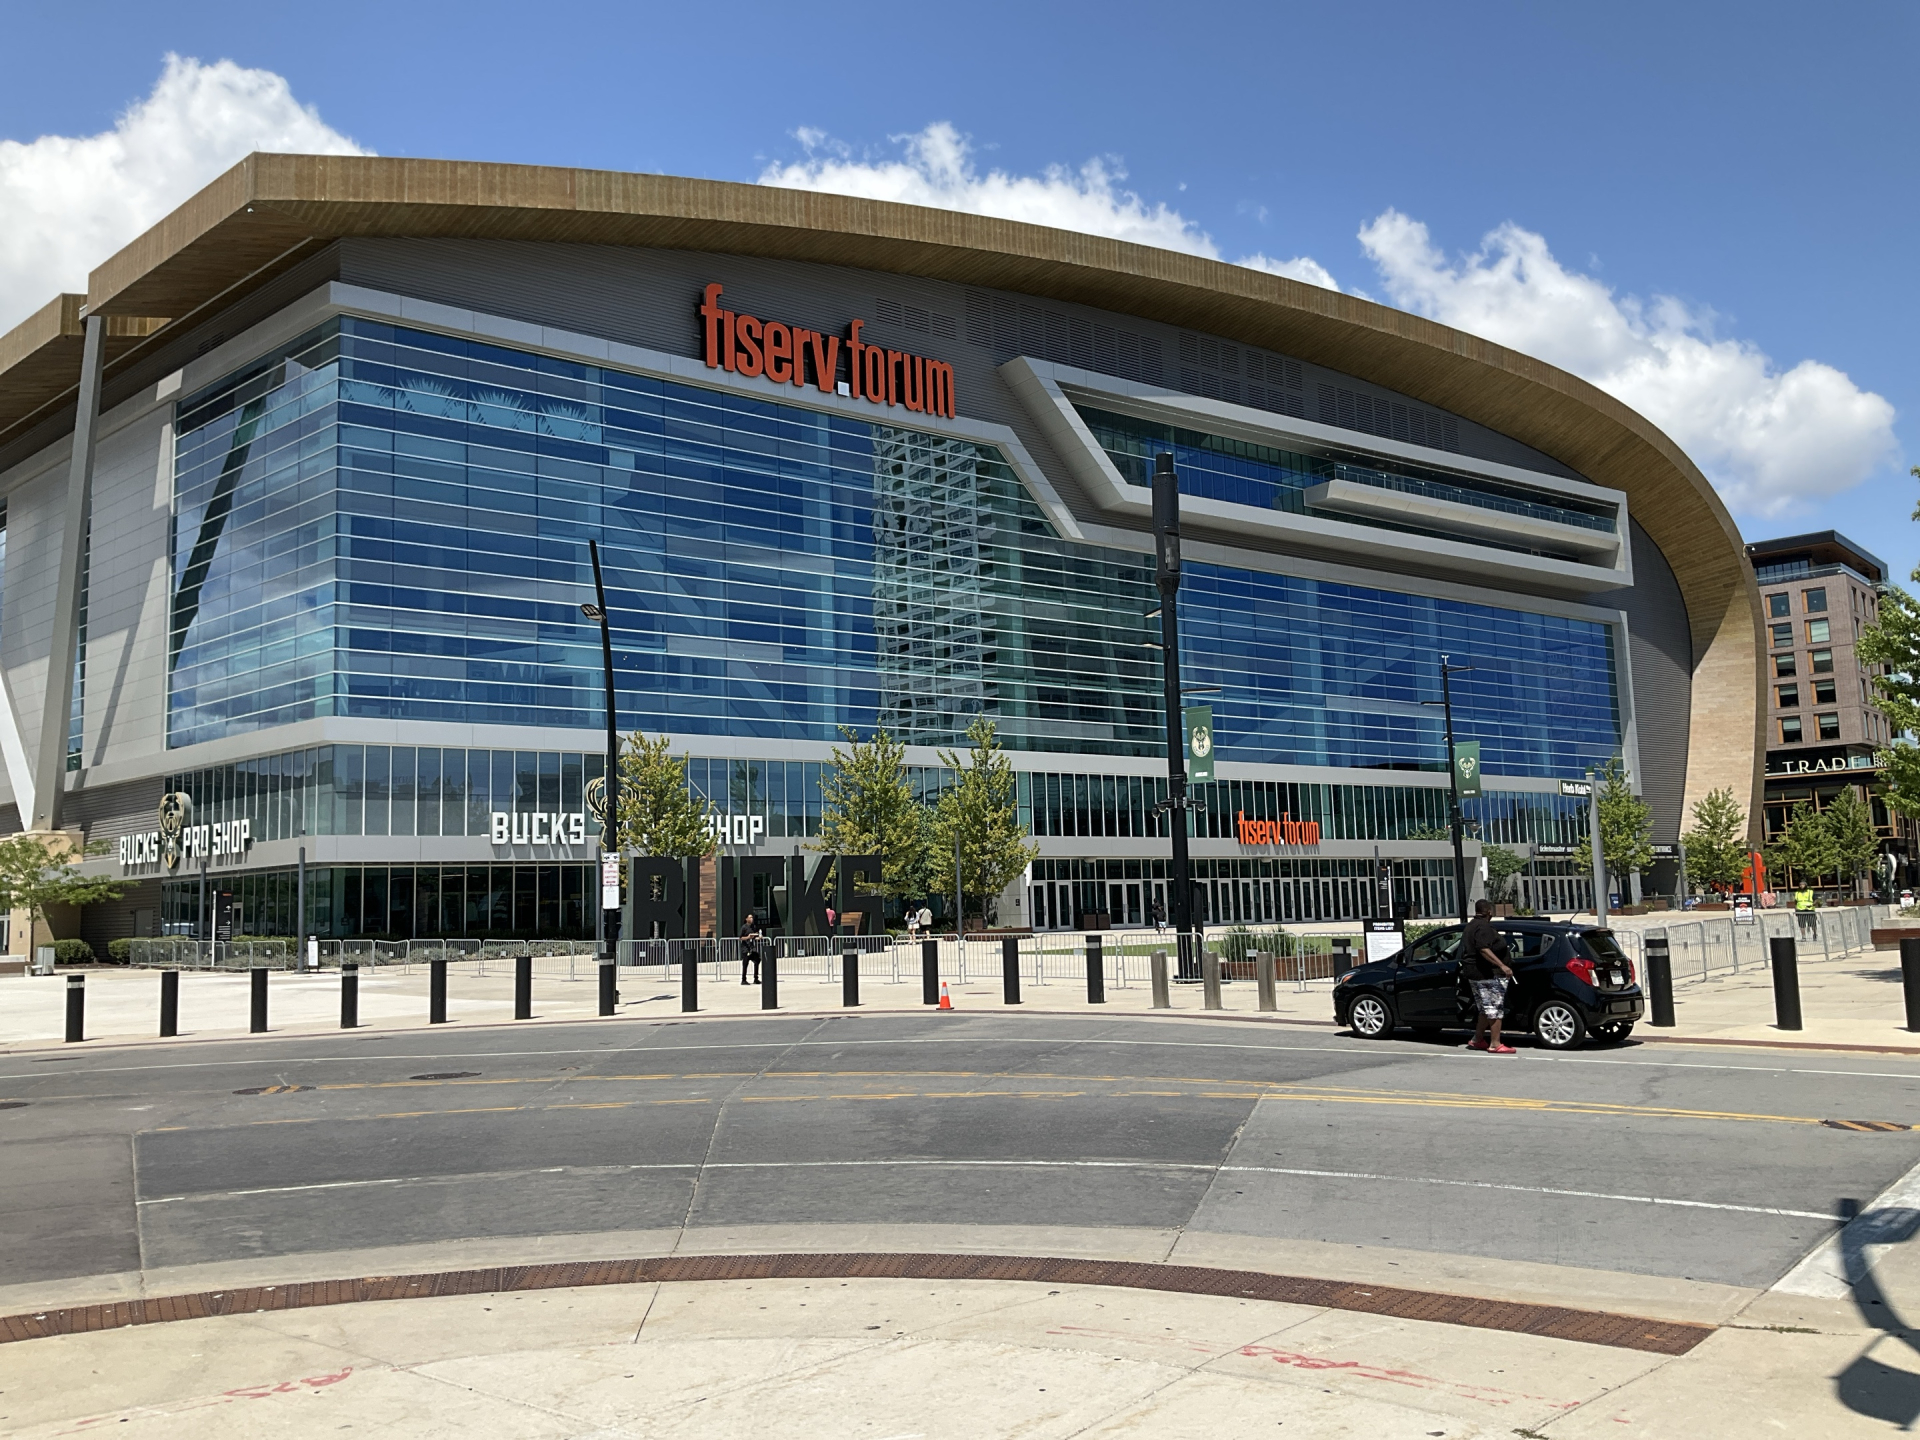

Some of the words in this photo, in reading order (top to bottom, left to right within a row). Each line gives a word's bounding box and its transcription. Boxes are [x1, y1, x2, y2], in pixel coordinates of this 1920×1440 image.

[1782, 755, 1861, 775] TRADE
[119, 831, 159, 866] BUCKS
[183, 824, 209, 859] PRO
[212, 818, 250, 855] SHOP
[491, 812, 585, 845] BUCKS
[700, 815, 763, 845] SHOP
[628, 855, 885, 966] BUCKS
